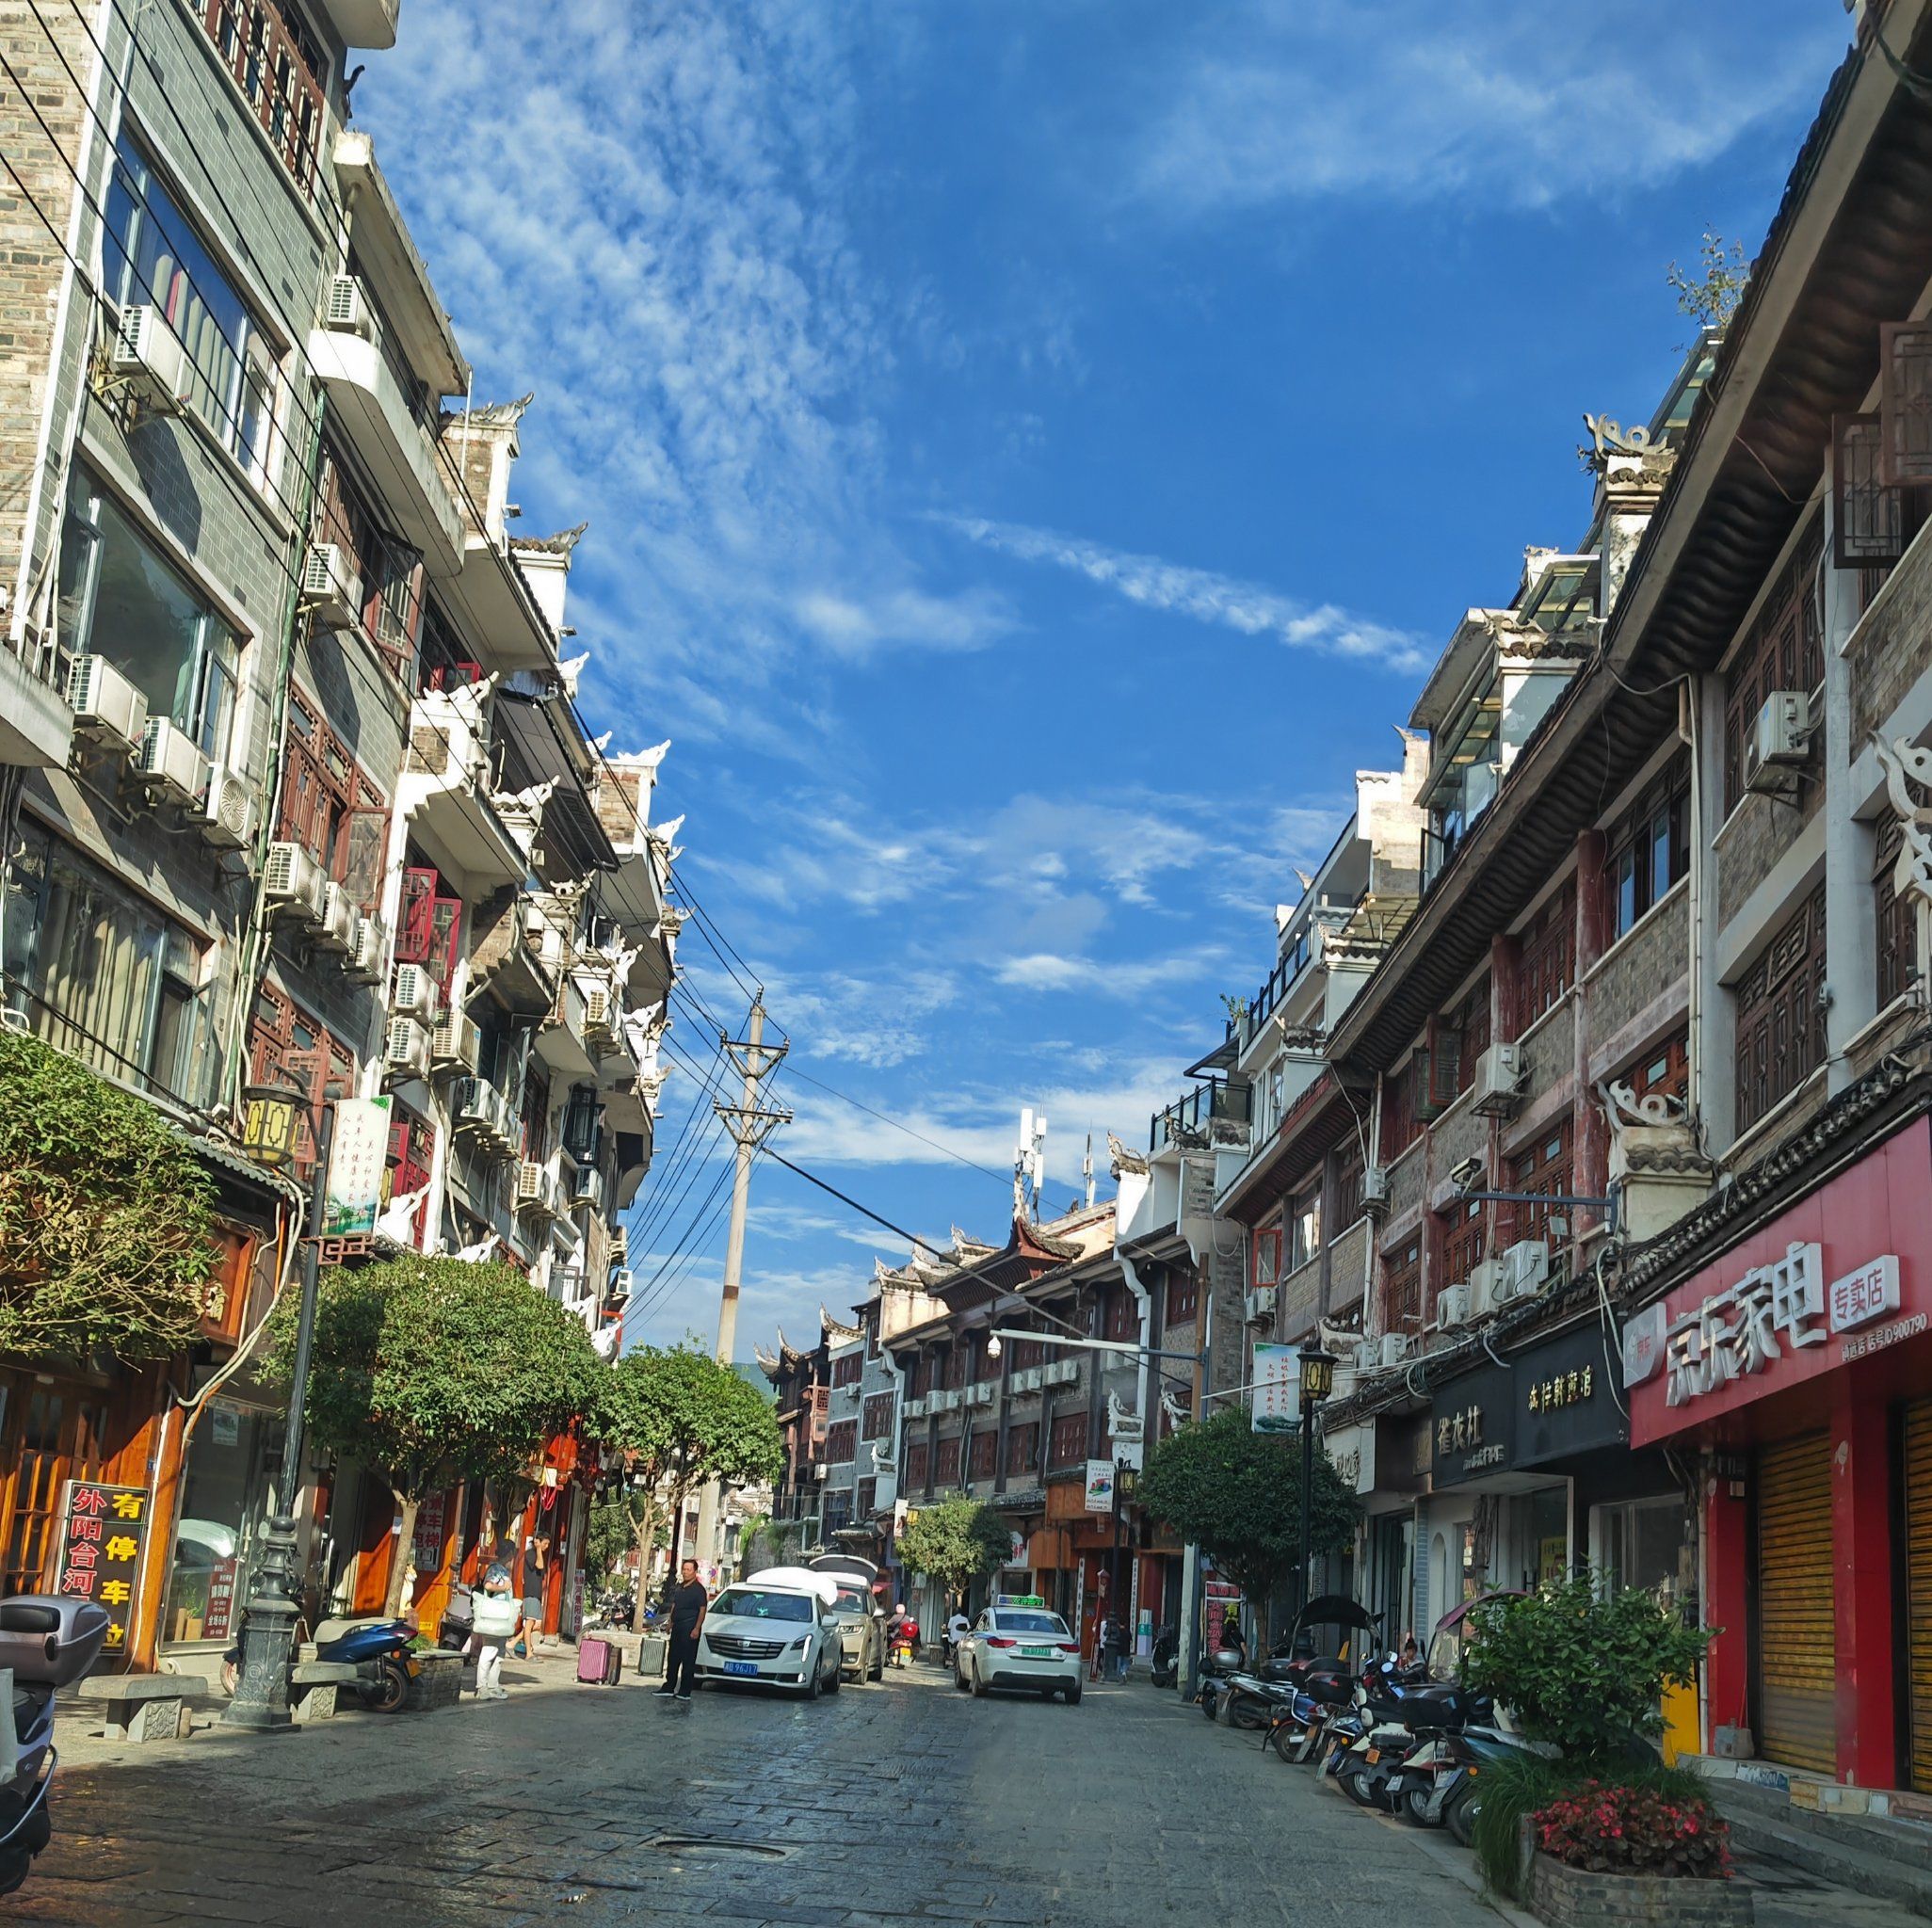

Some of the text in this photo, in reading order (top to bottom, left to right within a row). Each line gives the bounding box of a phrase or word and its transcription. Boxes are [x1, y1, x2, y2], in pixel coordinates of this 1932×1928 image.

[1666, 1241, 1827, 1407] 京东家电
[1834, 1268, 1883, 1320] 专卖店
[62, 1488, 107, 1602] 外阳台河
